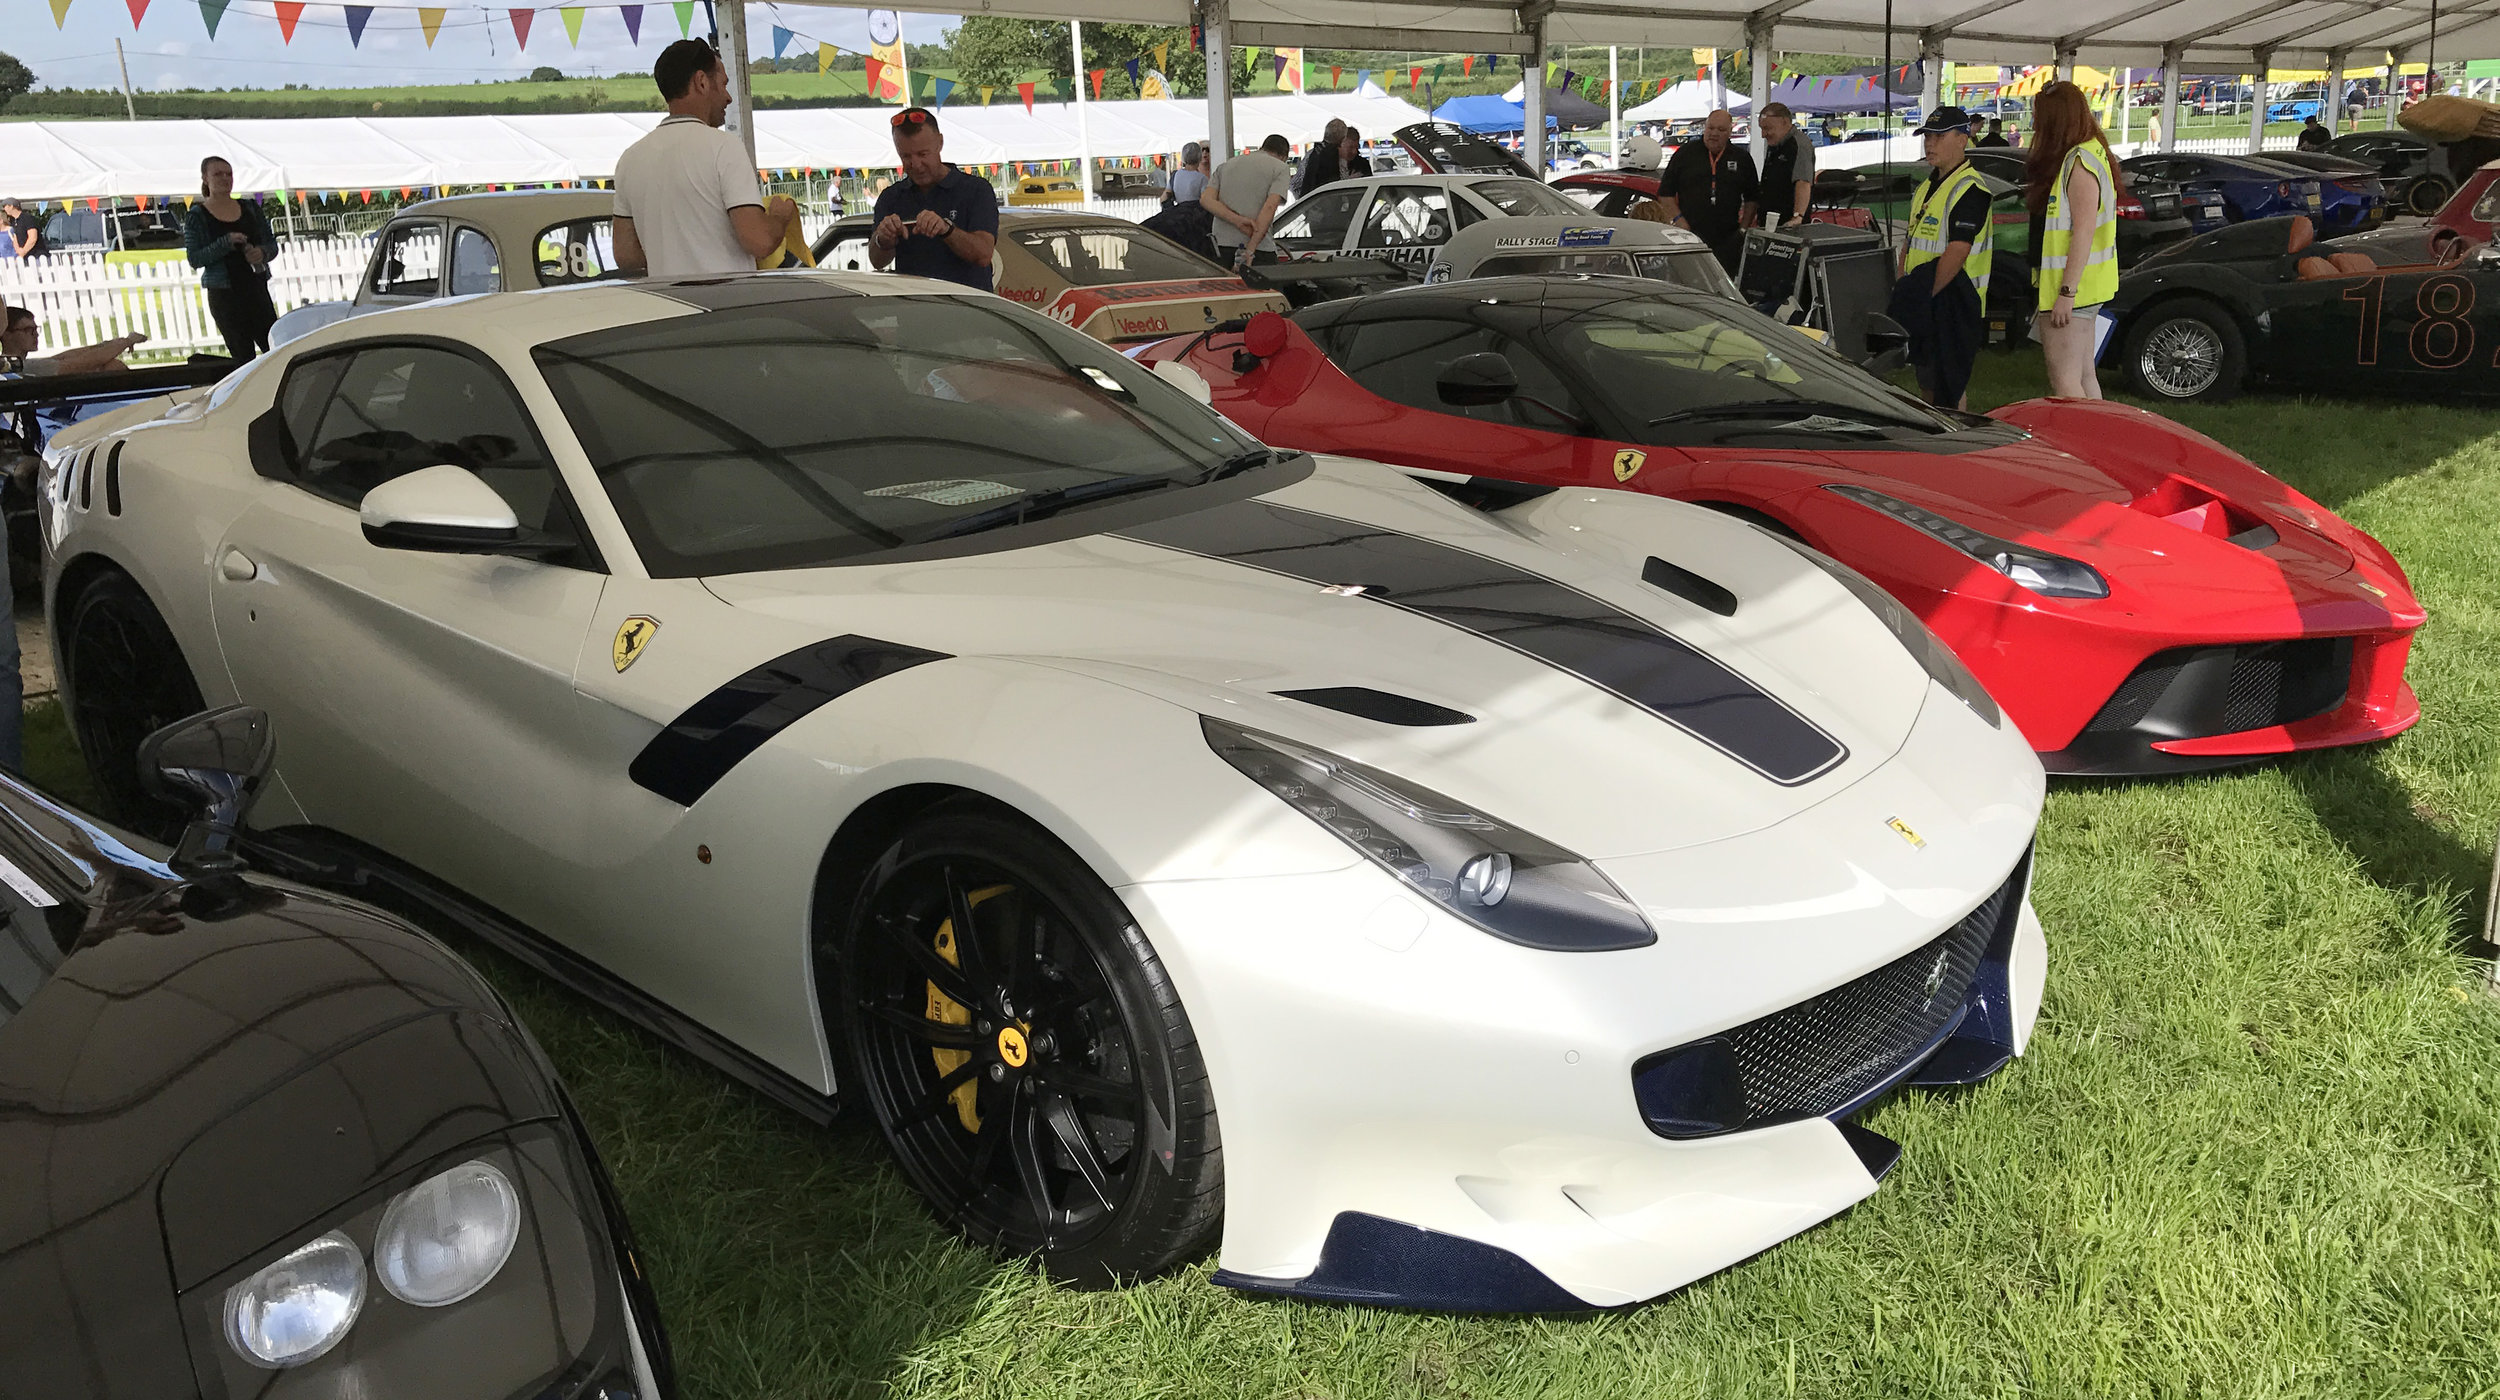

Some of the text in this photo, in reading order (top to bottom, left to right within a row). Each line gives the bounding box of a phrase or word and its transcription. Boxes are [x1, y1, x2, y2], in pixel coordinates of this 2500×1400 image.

[1497, 237, 1558, 246] RALLY STAGE
[547, 241, 589, 277] 38
[997, 286, 1047, 303] Veedol
[1117, 316, 1169, 334] Veedol
[2343, 274, 2500, 368] 18
